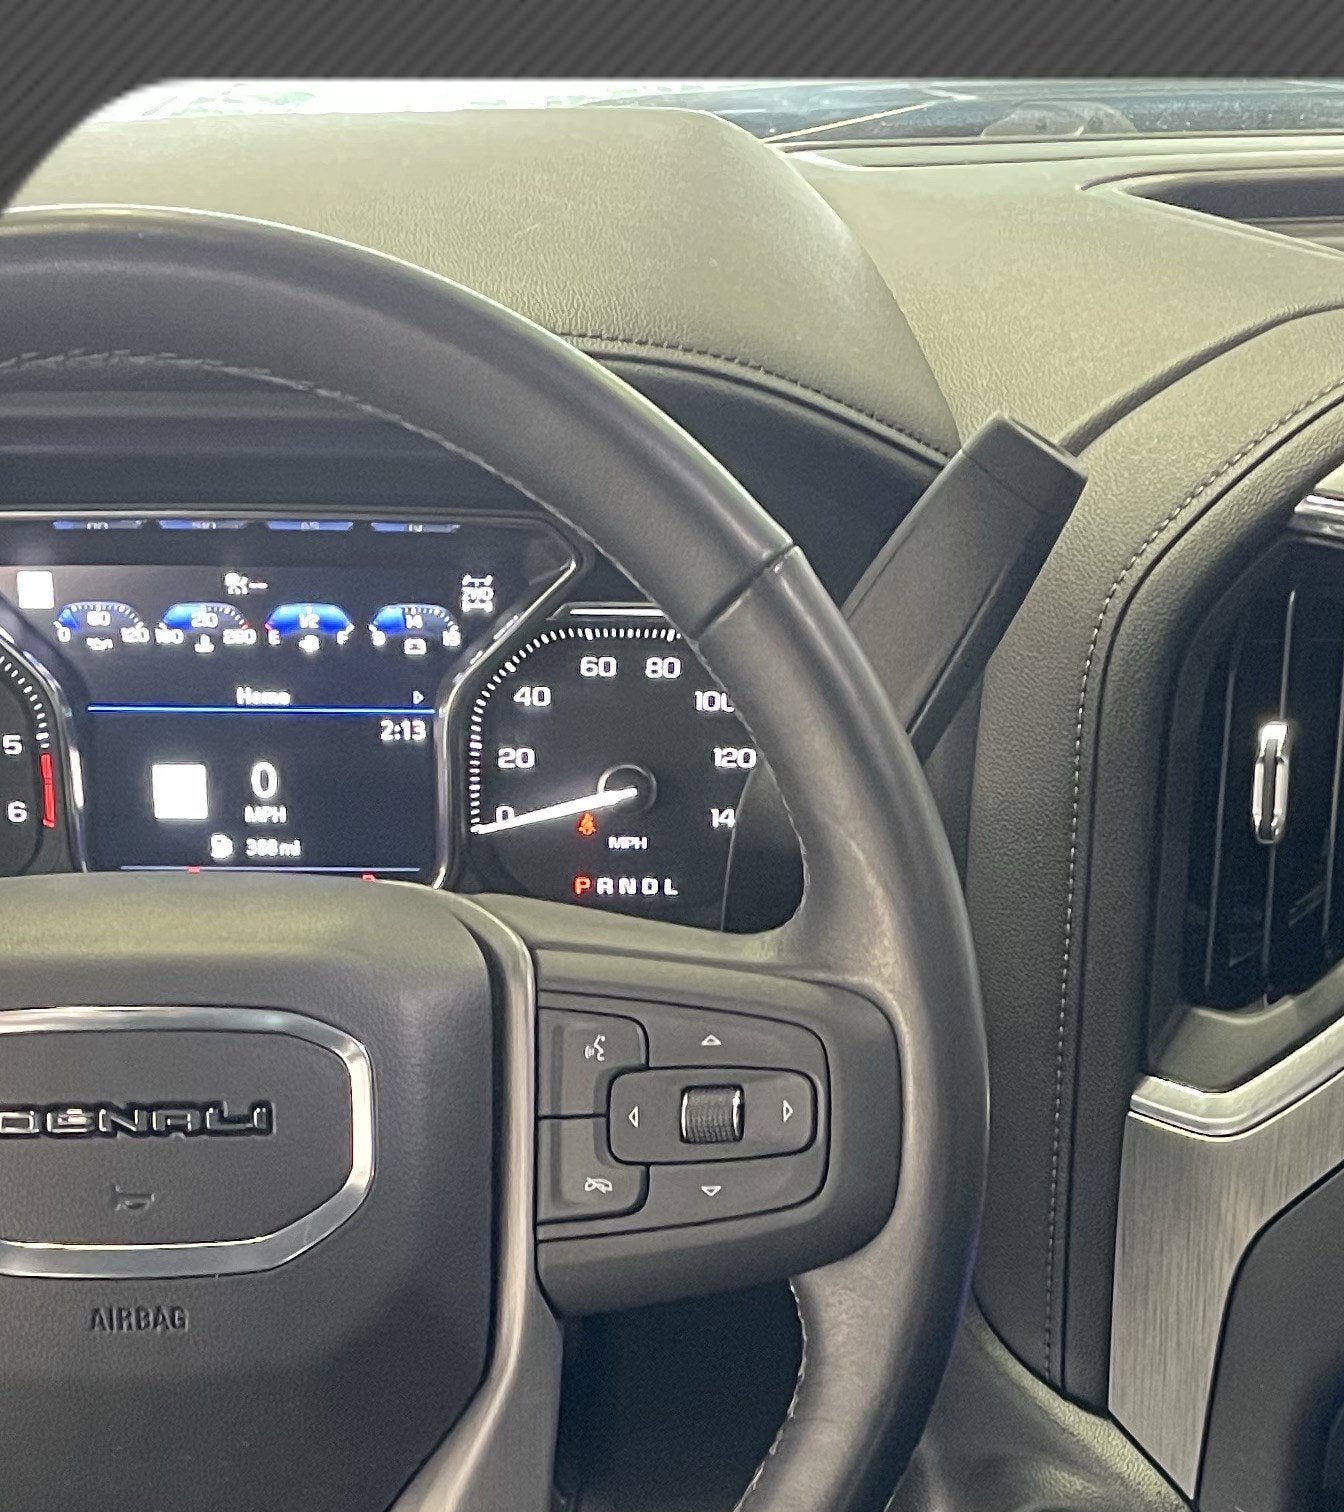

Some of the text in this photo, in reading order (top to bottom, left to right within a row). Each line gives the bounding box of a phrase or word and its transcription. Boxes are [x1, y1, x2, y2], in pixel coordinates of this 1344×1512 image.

[579, 656, 618, 677] 60
[644, 656, 682, 678] 80
[236, 687, 291, 705] Home
[513, 686, 552, 706] 40
[380, 719, 426, 741] 2:13
[2, 734, 22, 756] 5
[497, 747, 536, 769] 20
[713, 747, 757, 768] 120
[250, 761, 278, 799] 0
[6, 801, 27, 823] 6
[244, 805, 287, 823] MPH
[494, 805, 515, 824] 0
[608, 836, 648, 850] MPH
[618, 877, 638, 895] N
[663, 878, 678, 895] L
[90, 1304, 189, 1334] AIRBAG
